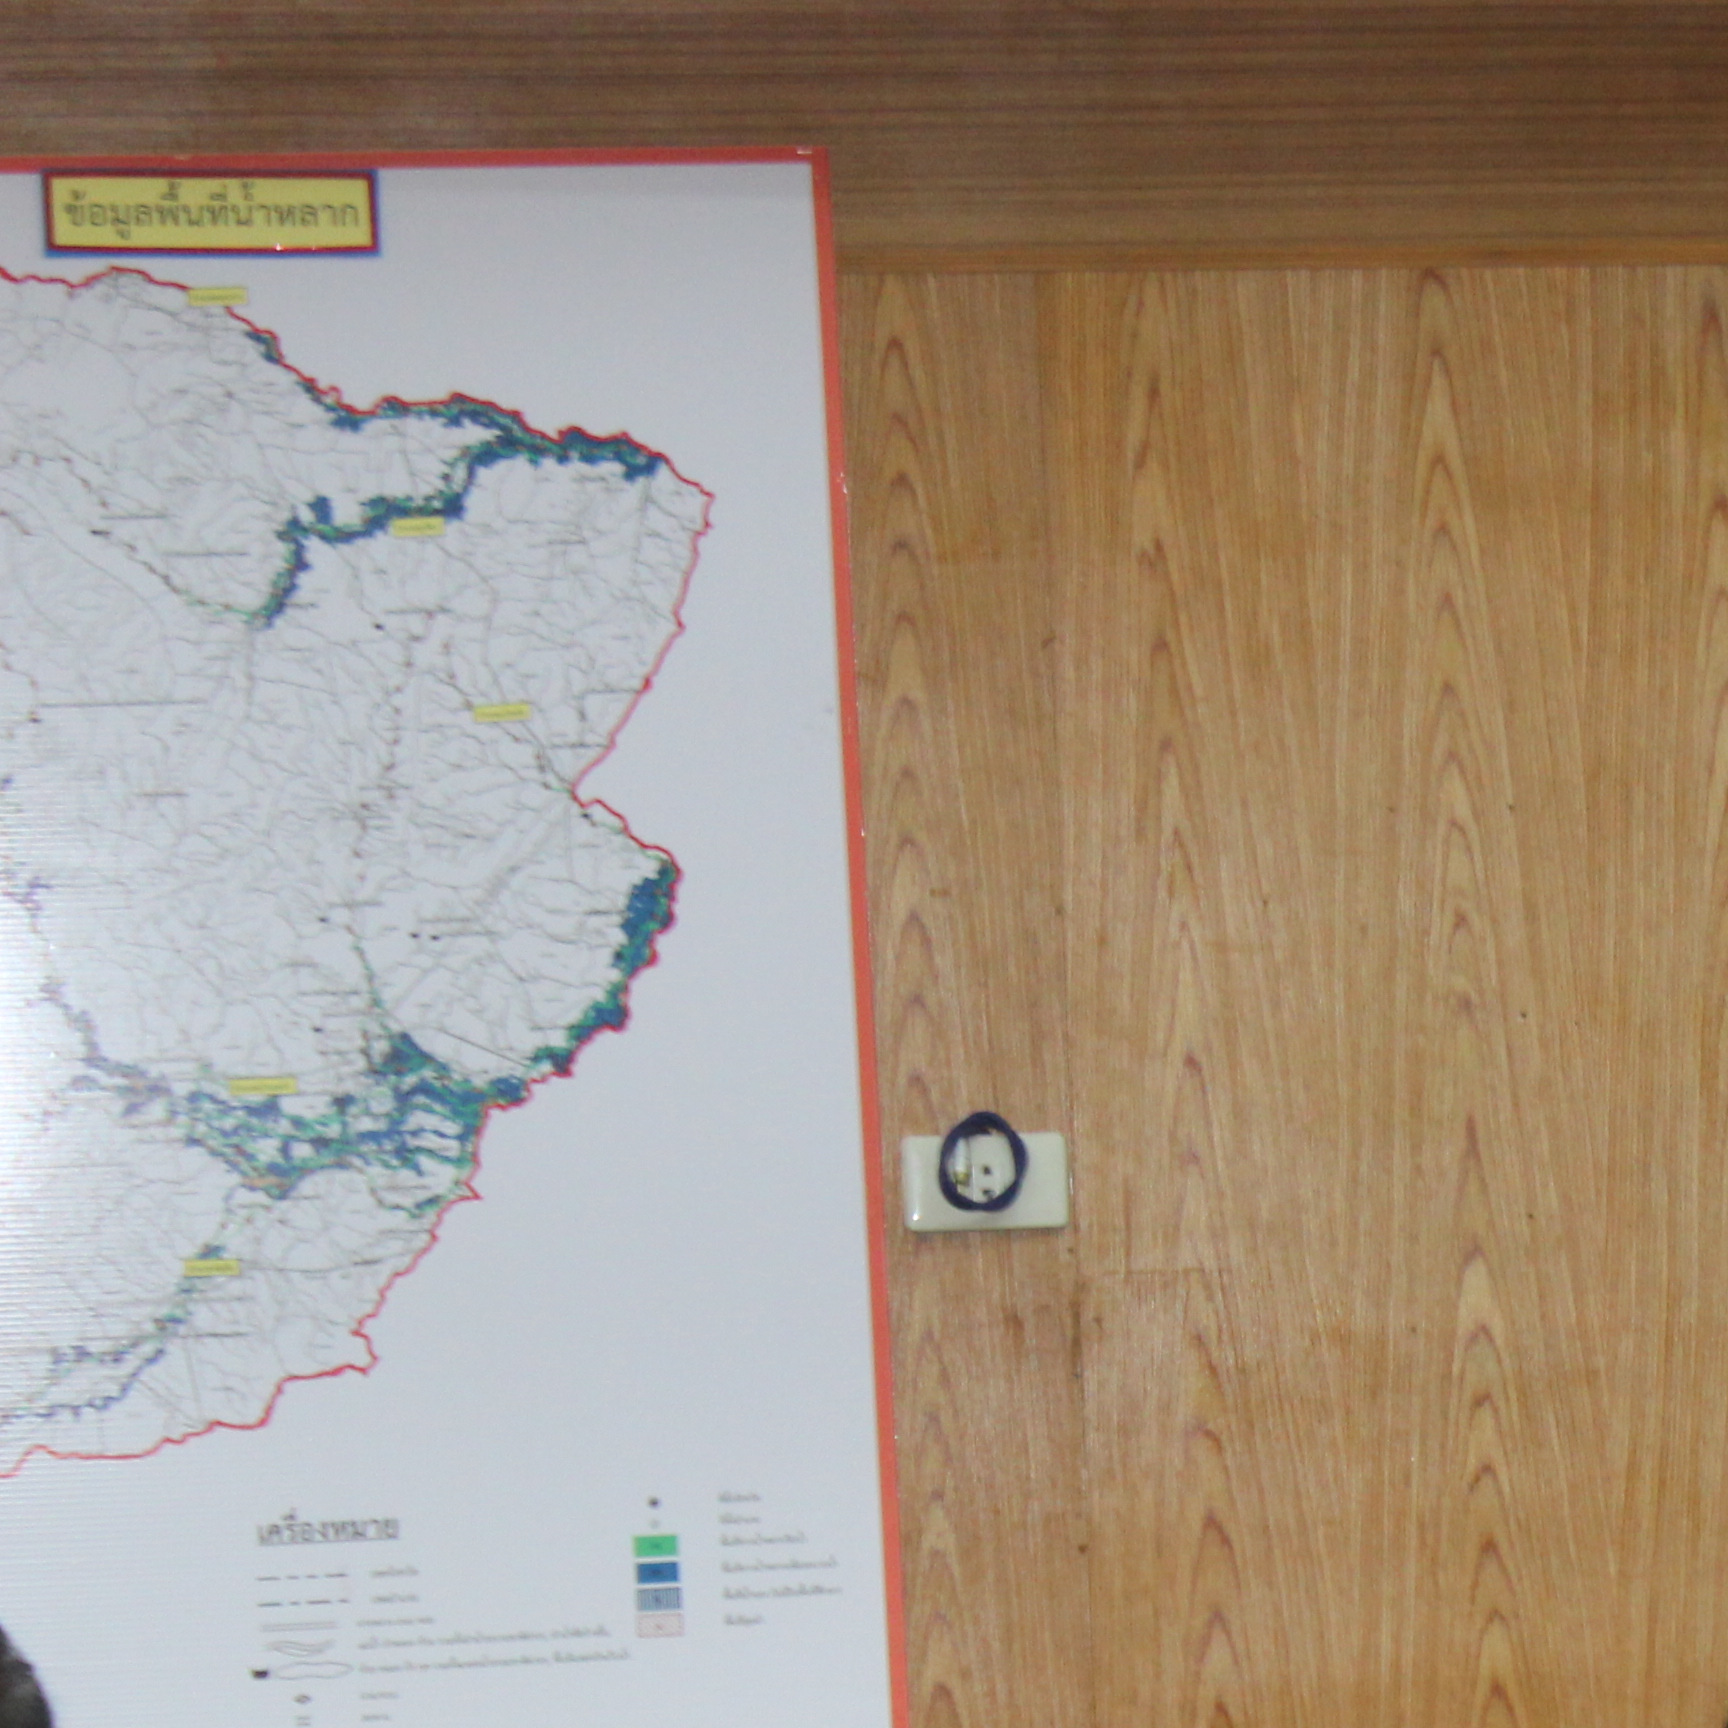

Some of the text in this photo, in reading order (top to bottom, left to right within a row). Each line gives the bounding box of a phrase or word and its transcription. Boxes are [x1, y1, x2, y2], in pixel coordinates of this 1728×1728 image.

[63, 181, 360, 241] ข้อมูลพื้นที่น้ำหลาก
[256, 1506, 400, 1546] เครื่องหมาย
